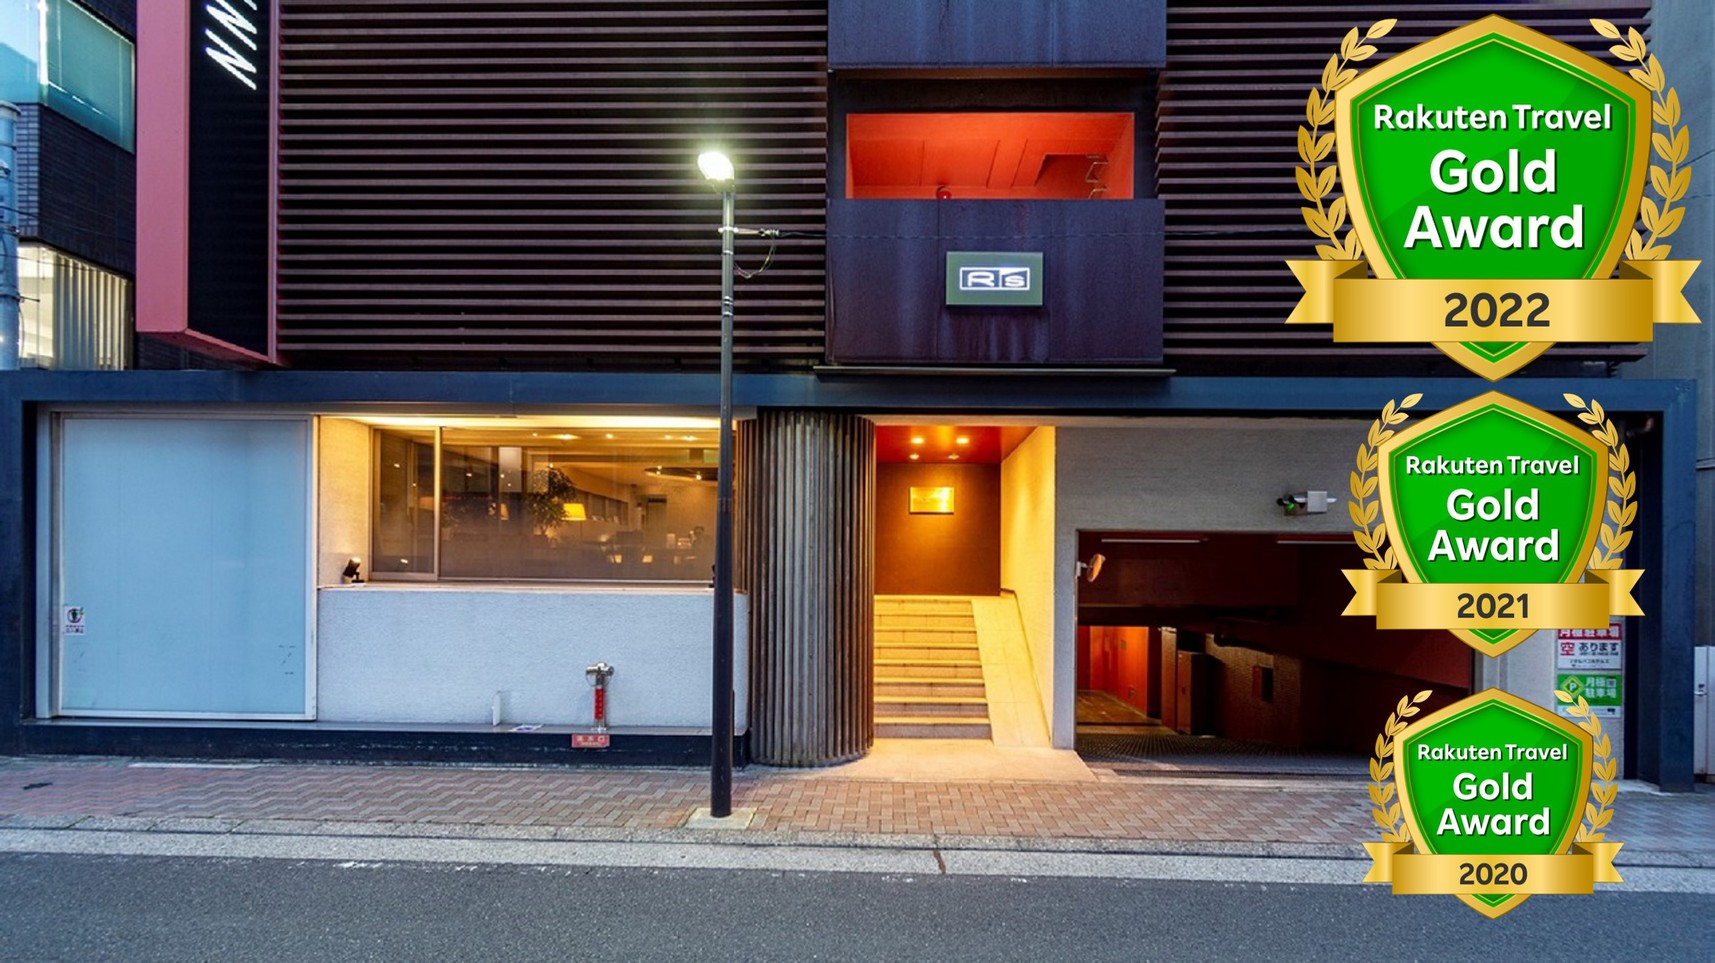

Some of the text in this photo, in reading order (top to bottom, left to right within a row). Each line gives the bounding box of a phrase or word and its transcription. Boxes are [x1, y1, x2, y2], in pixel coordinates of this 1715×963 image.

[1561, 642, 1575, 656] 空
[1579, 642, 1619, 652] あります
